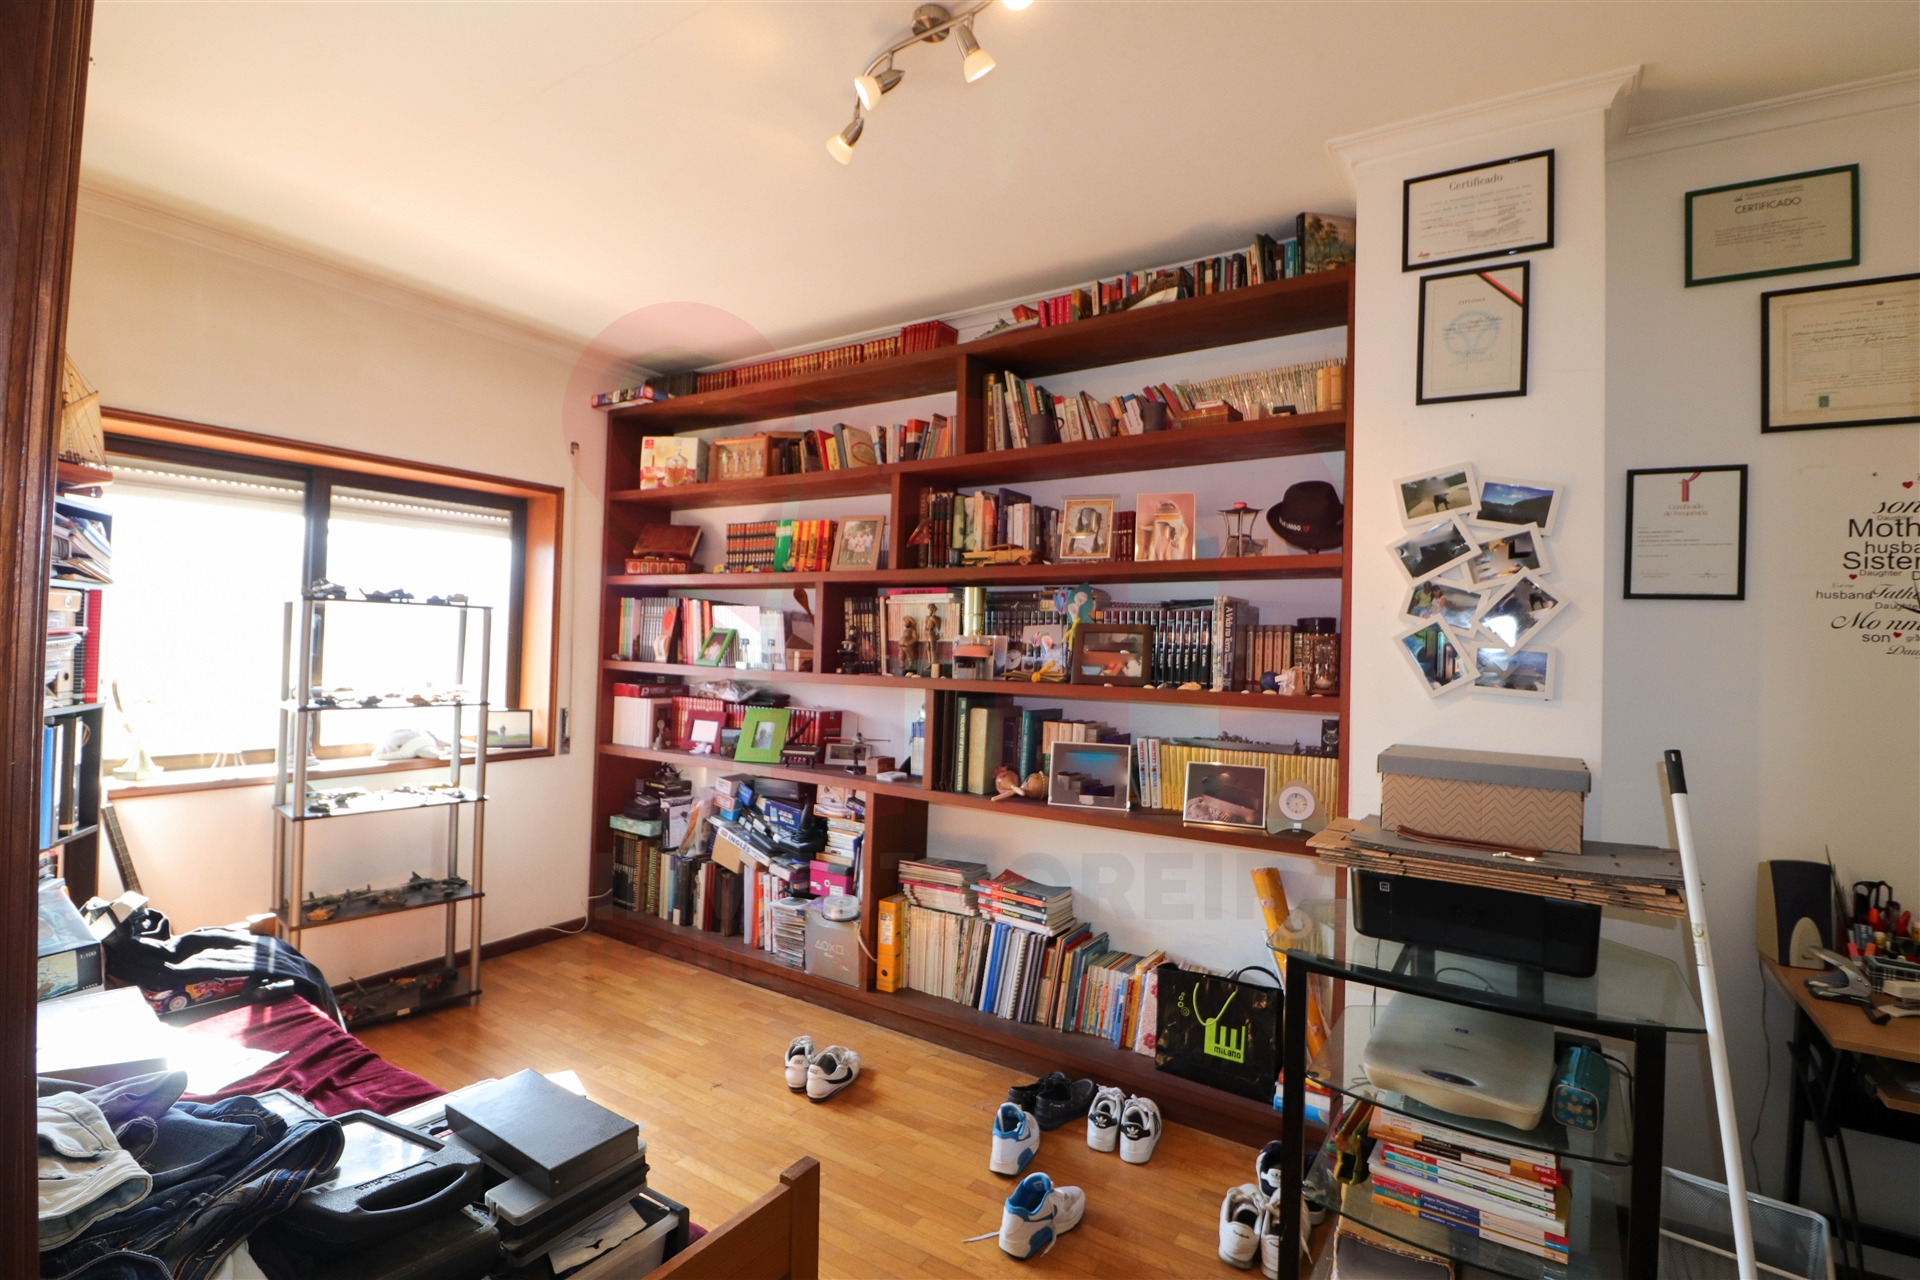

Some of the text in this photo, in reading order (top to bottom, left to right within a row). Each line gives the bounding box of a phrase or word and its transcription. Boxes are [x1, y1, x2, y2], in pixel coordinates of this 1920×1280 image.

[1449, 173, 1504, 191] Certificado
[1734, 196, 1802, 214] CERTIFICADO
[1859, 569, 1903, 577] Daughter
[1815, 590, 1873, 600] husband
[1225, 613, 1233, 627] Vida
[1862, 634, 1891, 643] son
[1224, 636, 1233, 652] Terra
[728, 833, 751, 854] INGLÊS
[80, 951, 97, 959] 1:100
[1534, 1166, 1551, 1175] areal
[1540, 1176, 1557, 1185] areal
